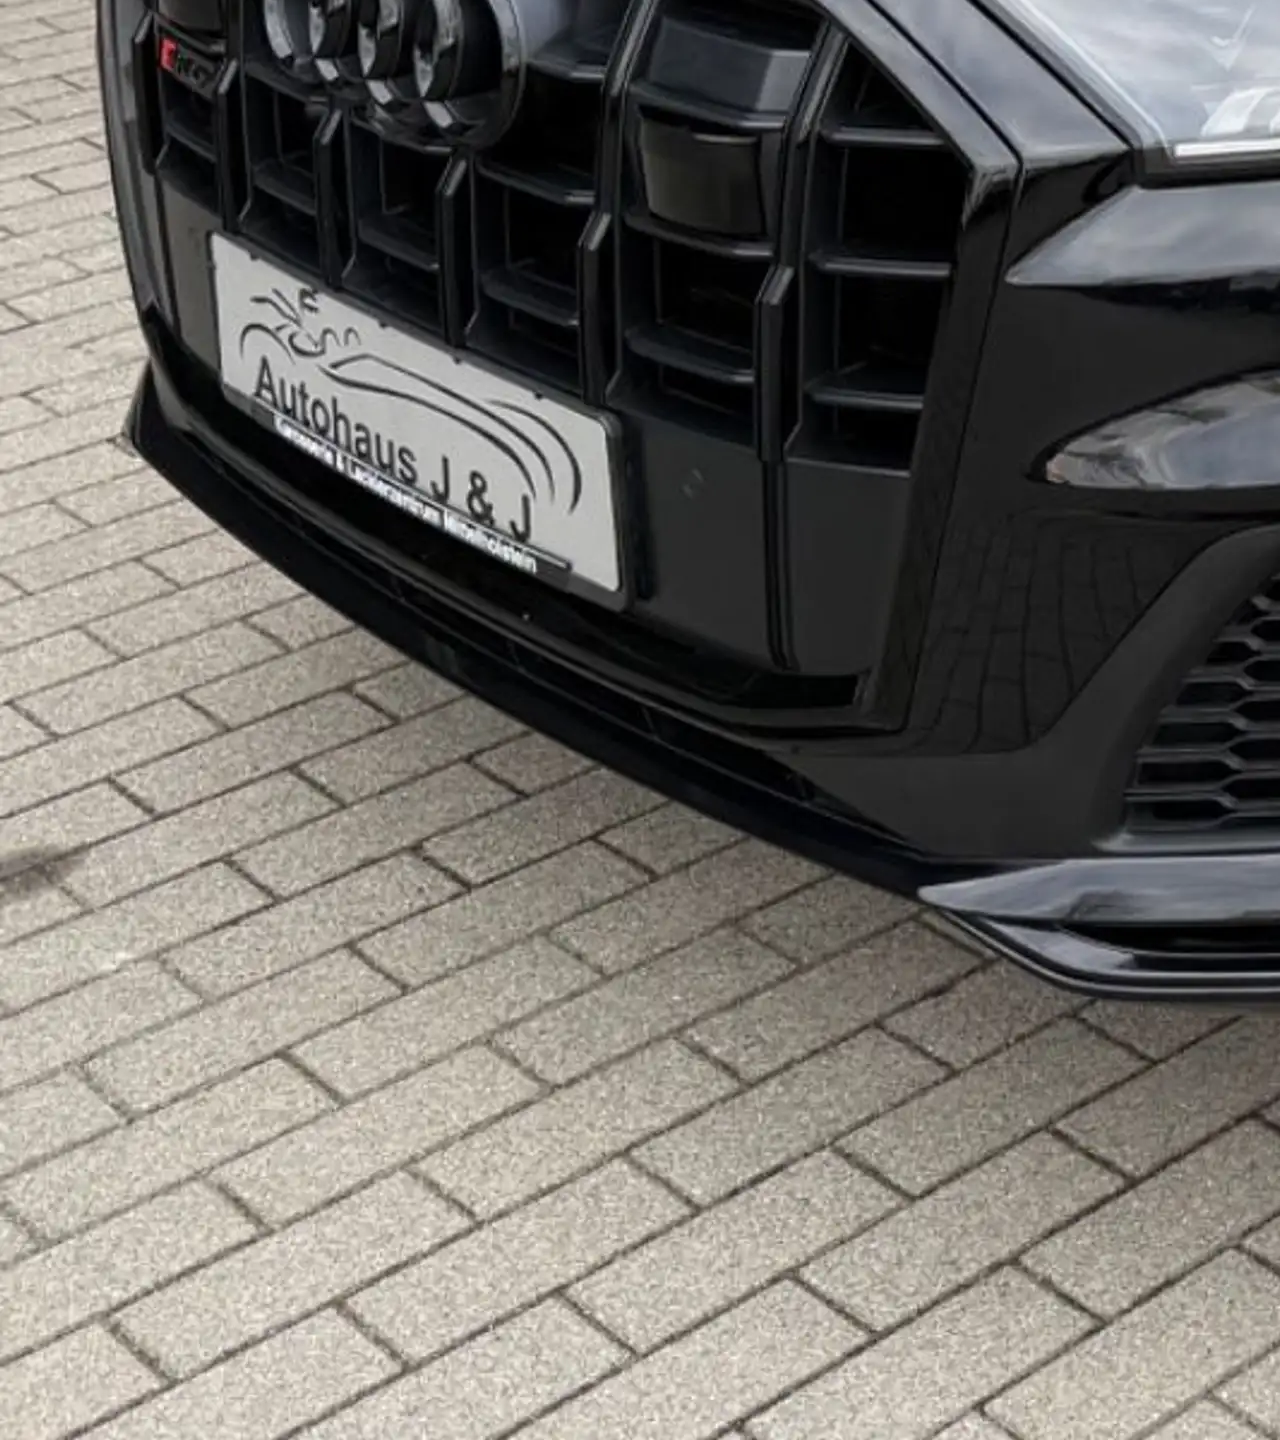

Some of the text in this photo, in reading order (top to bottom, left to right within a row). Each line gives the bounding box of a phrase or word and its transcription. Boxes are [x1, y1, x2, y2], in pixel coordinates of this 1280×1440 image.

[254, 354, 532, 544] Autohaus J & J
